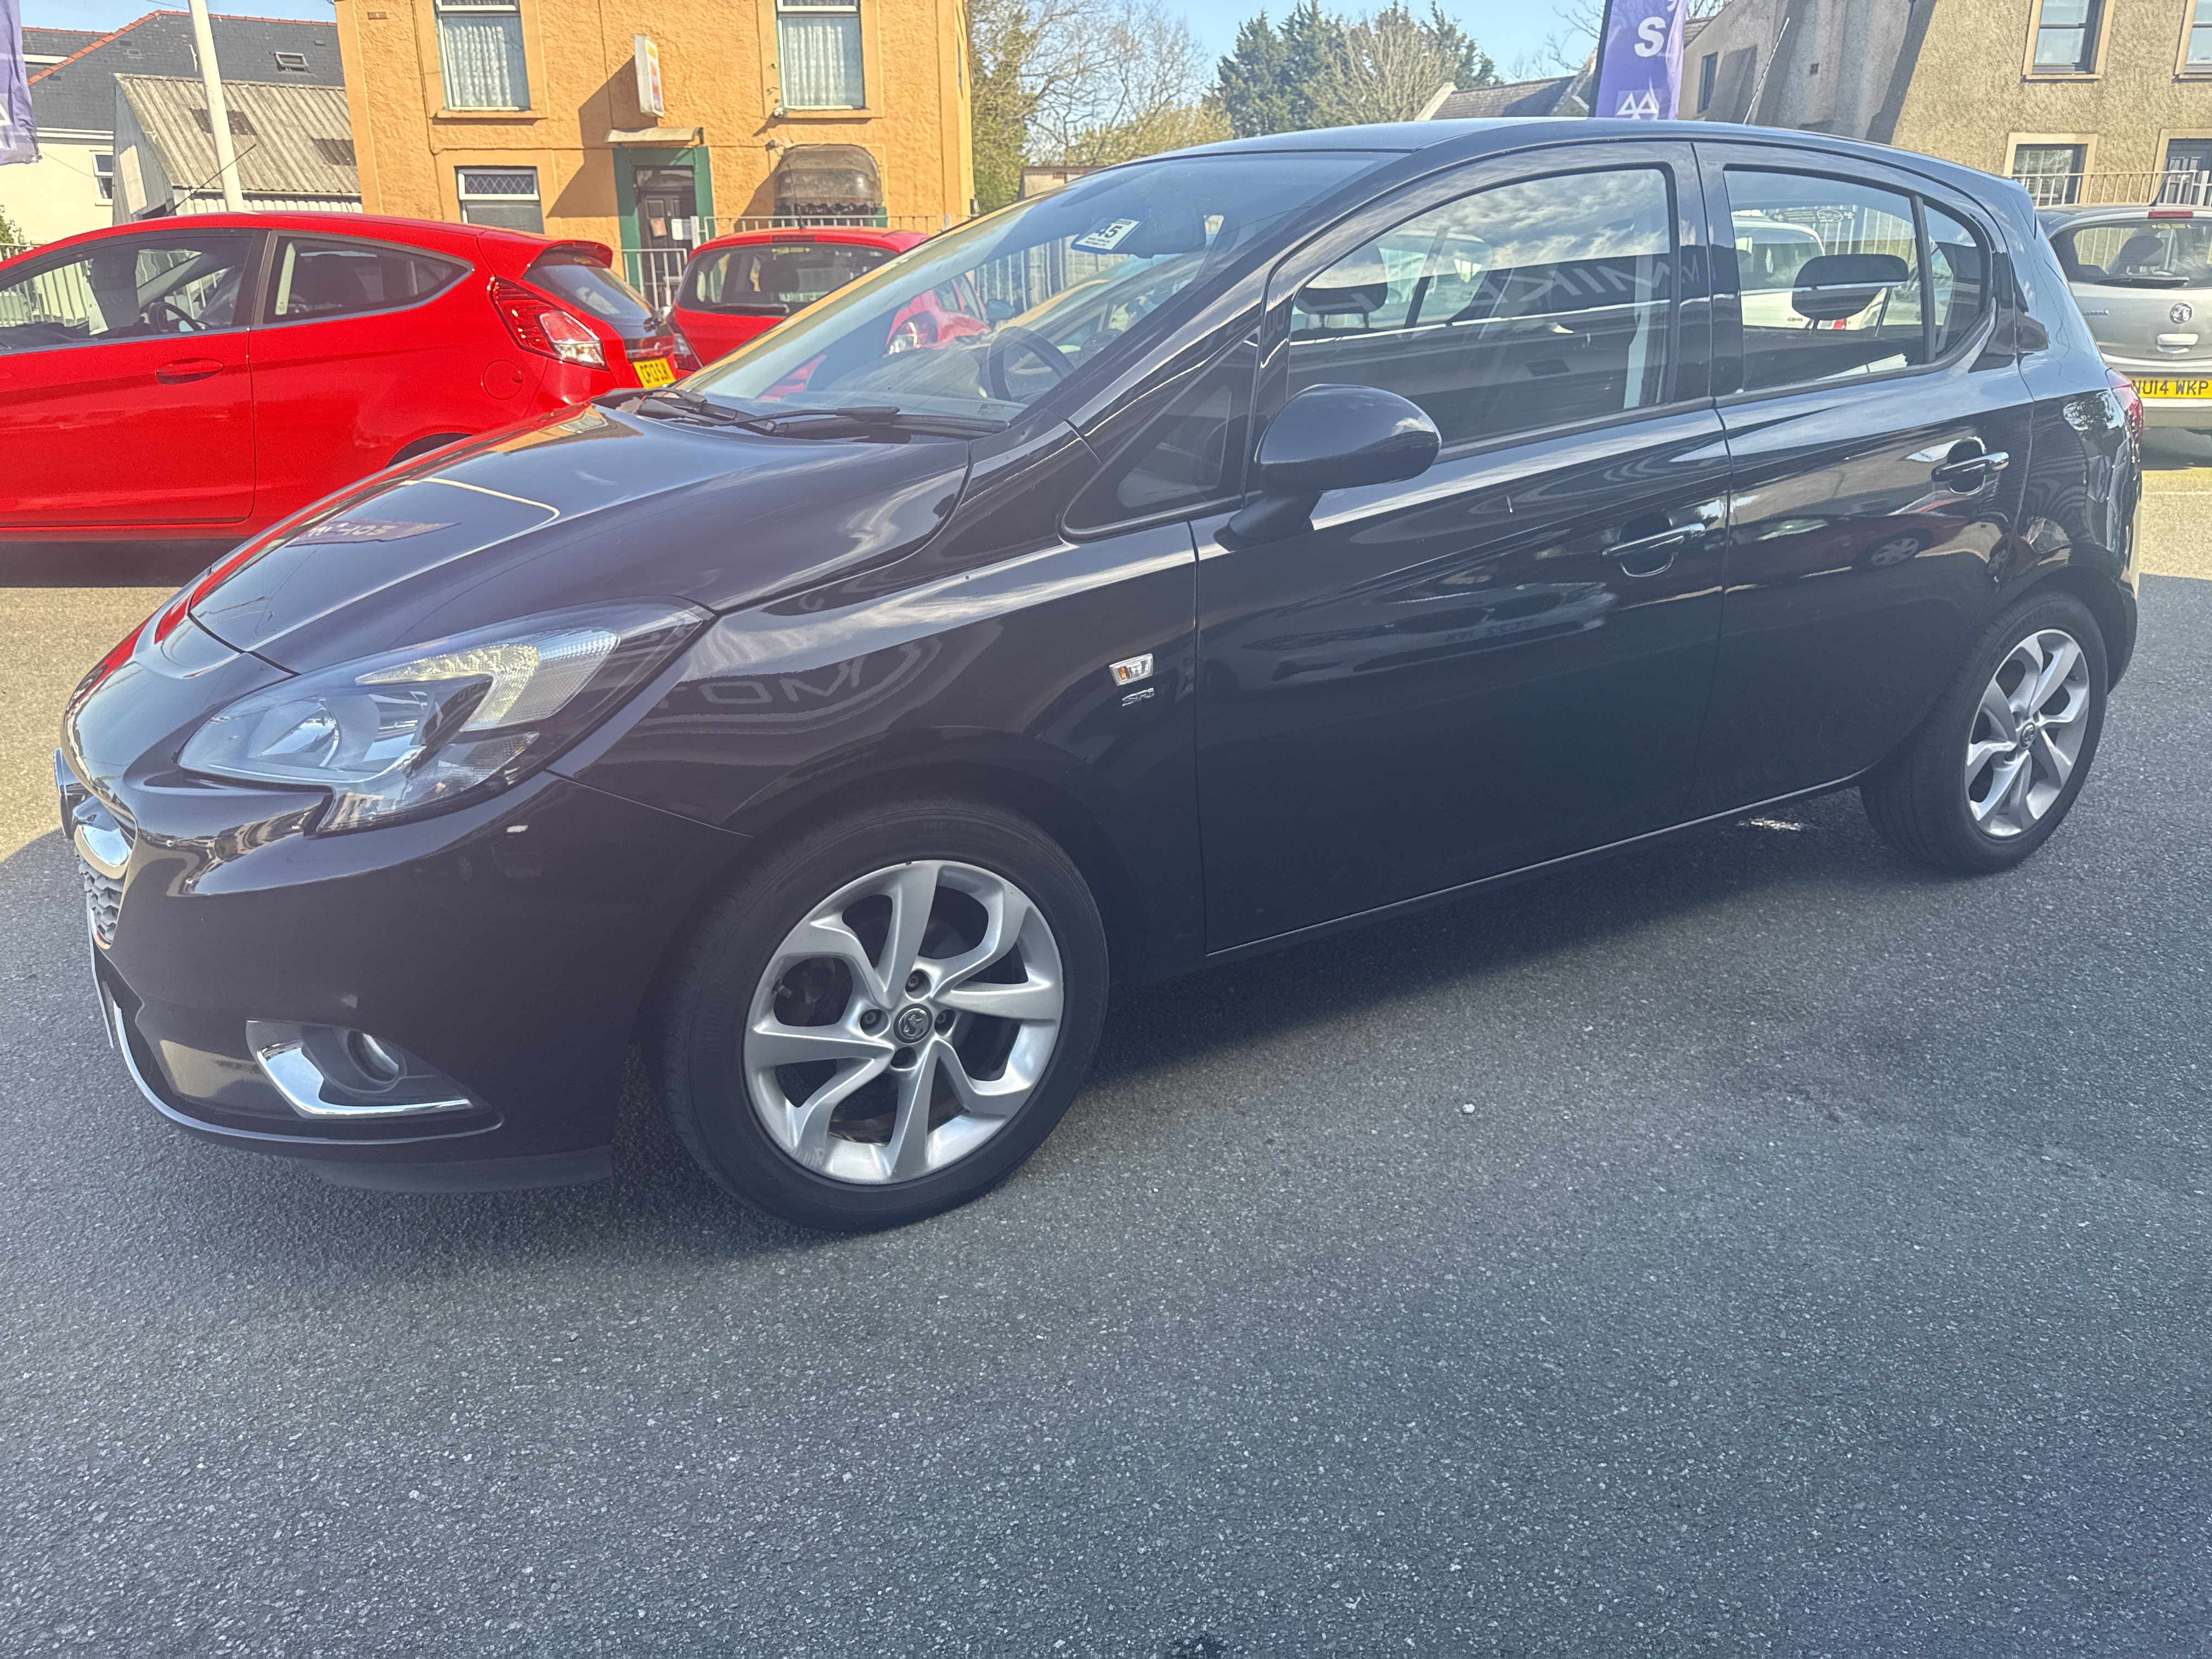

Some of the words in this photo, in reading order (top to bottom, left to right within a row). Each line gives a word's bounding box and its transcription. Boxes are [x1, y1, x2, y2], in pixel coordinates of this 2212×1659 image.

[1096, 224, 1123, 238] 45
[2132, 380, 2169, 394] NU14
[2176, 380, 2209, 395] WKP
